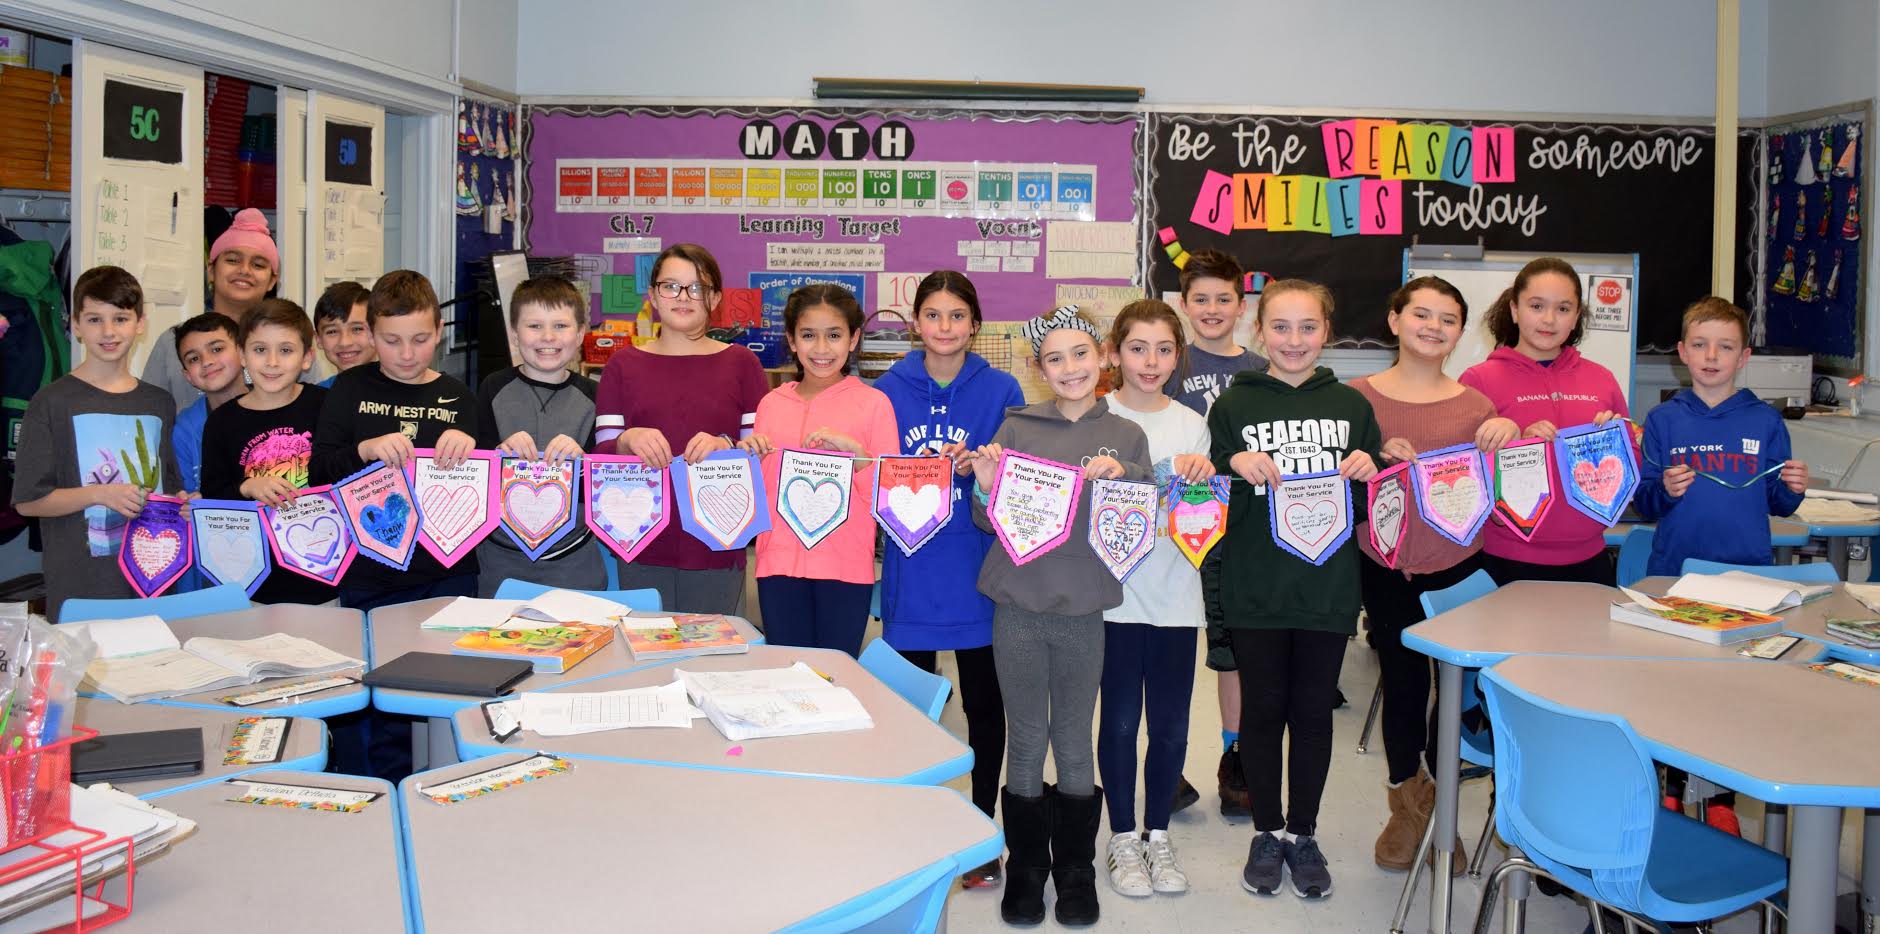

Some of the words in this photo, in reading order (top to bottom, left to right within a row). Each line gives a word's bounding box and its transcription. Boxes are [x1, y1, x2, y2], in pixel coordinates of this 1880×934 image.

[130, 105, 160, 142] 5C
[744, 125, 908, 160] MATH
[338, 138, 358, 166] 5D
[1167, 123, 1215, 161] Be
[1231, 125, 1306, 175] the
[1338, 124, 1501, 180] REASON
[1527, 132, 1702, 177] someone
[868, 171, 892, 179] TENS
[980, 173, 1012, 181] TENTHS
[103, 178, 118, 199] Table
[123, 184, 128, 201] 1
[828, 182, 855, 195] 100
[872, 182, 891, 194] 10
[916, 182, 921, 196] 1
[987, 184, 1000, 199] .1
[1021, 183, 1046, 198] .01
[1060, 188, 1087, 200] .001
[1207, 178, 1390, 230] SMILES
[1412, 180, 1547, 237] today
[100, 205, 117, 224] Table
[122, 208, 128, 227] 2
[609, 214, 655, 234] Ch.7
[739, 213, 825, 240] Learning
[838, 215, 901, 242] Target
[976, 219, 1043, 240] Vocab
[98, 231, 115, 251] Table
[120, 234, 128, 252] 3
[760, 279, 788, 290] Order
[791, 277, 802, 286] of
[609, 276, 636, 308] E
[1599, 287, 1621, 297] STOP
[729, 288, 755, 320] S
[1183, 373, 1217, 394] NEW
[1517, 393, 1549, 402] BANANA
[1562, 394, 1599, 402] REPUBLIC
[359, 401, 391, 416] ARMY
[394, 405, 425, 420] WEST
[247, 432, 267, 448] FROM
[266, 426, 295, 437] WATER
[1241, 418, 1350, 453] SEAFORD
[1568, 442, 1587, 450] Thank
[1588, 439, 1601, 447] You
[1602, 436, 1614, 444] For
[1285, 446, 1298, 454] EST.
[1299, 445, 1316, 454] 1643
[1571, 449, 1587, 457] Your
[1589, 444, 1614, 454] Service
[1690, 444, 1724, 452] YORK
[792, 458, 813, 467] Thank
[830, 462, 842, 470] For
[1424, 462, 1444, 470] Thank
[1444, 465, 1470, 474] Service
[793, 467, 810, 475] Your
[812, 469, 839, 478] Service
[1013, 463, 1036, 474] Thank
[1038, 469, 1052, 478] You
[1053, 473, 1067, 481] For
[350, 483, 372, 496] Thank
[371, 478, 383, 487] You
[383, 472, 394, 481] For
[1015, 472, 1033, 482] Your
[1034, 477, 1062, 489] Service
[1307, 483, 1322, 491] You
[356, 492, 372, 502] Your
[372, 482, 395, 496] Service
[1122, 488, 1136, 496] You
[1306, 490, 1333, 498] Service
[1120, 497, 1146, 505] Service
[276, 505, 298, 514] Thank
[282, 513, 298, 521] Your
[300, 506, 326, 515] Service
